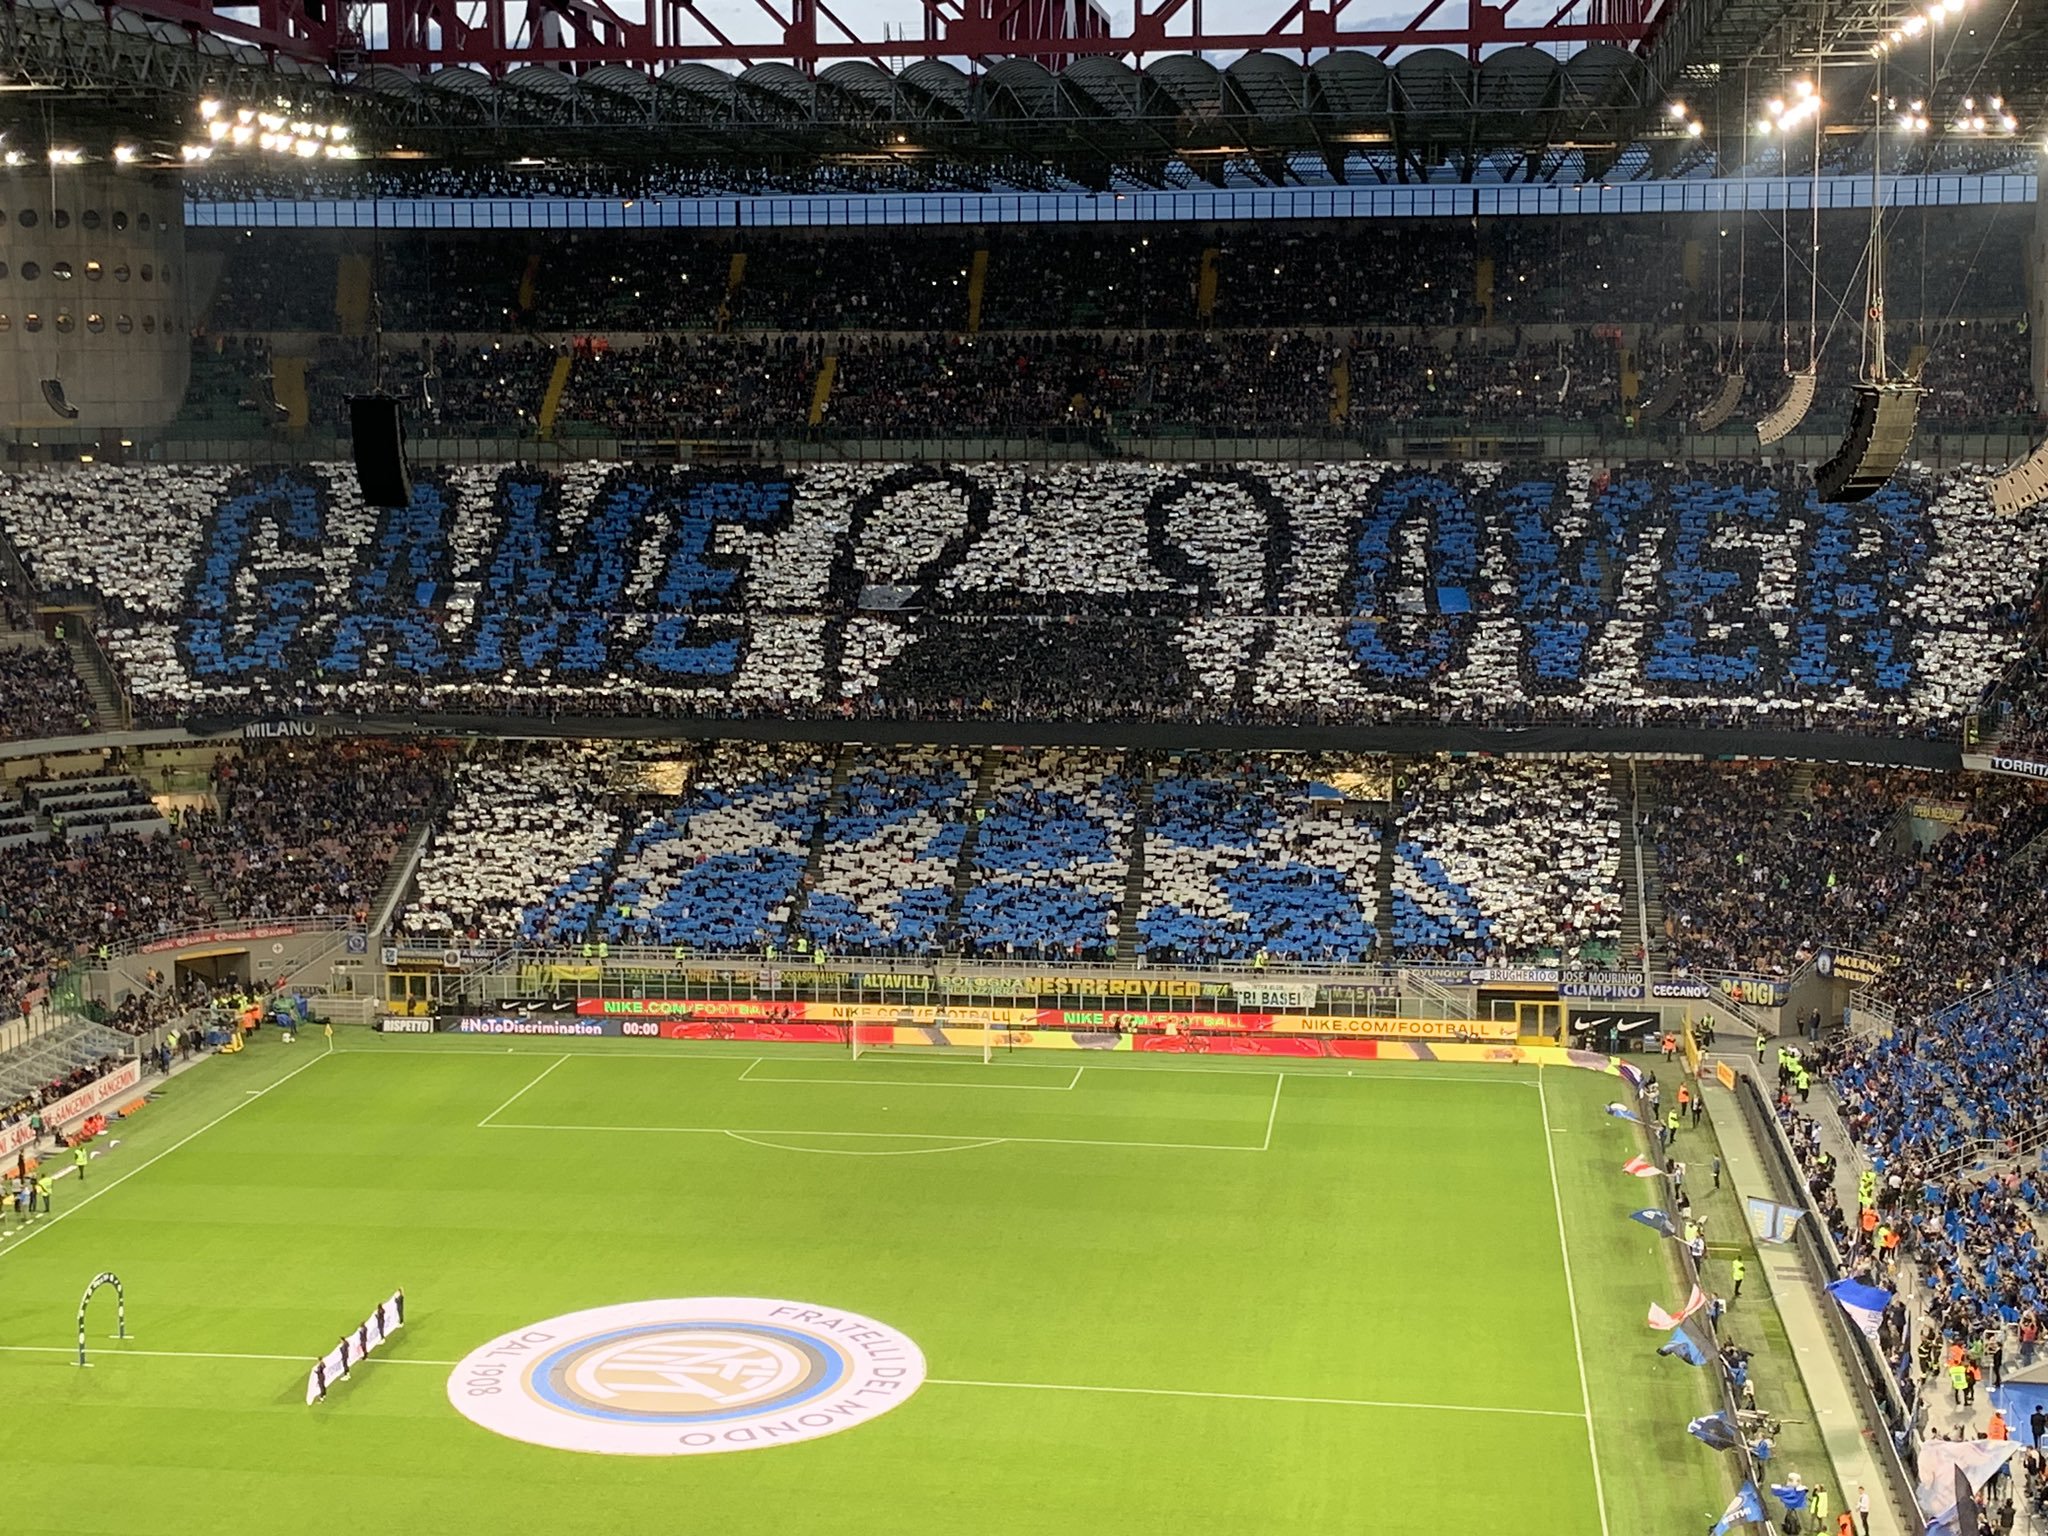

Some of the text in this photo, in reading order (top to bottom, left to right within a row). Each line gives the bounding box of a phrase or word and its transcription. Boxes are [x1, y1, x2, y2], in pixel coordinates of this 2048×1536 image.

[190, 464, 1931, 690] GAME OVER
[246, 719, 315, 739] MILANO
[863, 974, 930, 990] ALTAVILLA
[940, 976, 1023, 988] BOLOGNA
[1489, 970, 1546, 981] BRUGHERIO
[1589, 971, 1643, 984] MOURINHO
[1109, 979, 1200, 996] ROVIGO
[1333, 986, 1396, 999] MASATE
[1563, 984, 1641, 998] CIAMPINO
[1653, 985, 1701, 998] CECCANO
[383, 1019, 429, 1032] RISPETTO
[460, 1018, 602, 1036] #NoToDiscrimination
[623, 1022, 658, 1036] 00:00
[1302, 1018, 1489, 1035] NIKE.COM/FOOTBALL
[468, 1330, 557, 1397] DAL 1908
[679, 1306, 906, 1447] FRATELLI DEL MONDO
